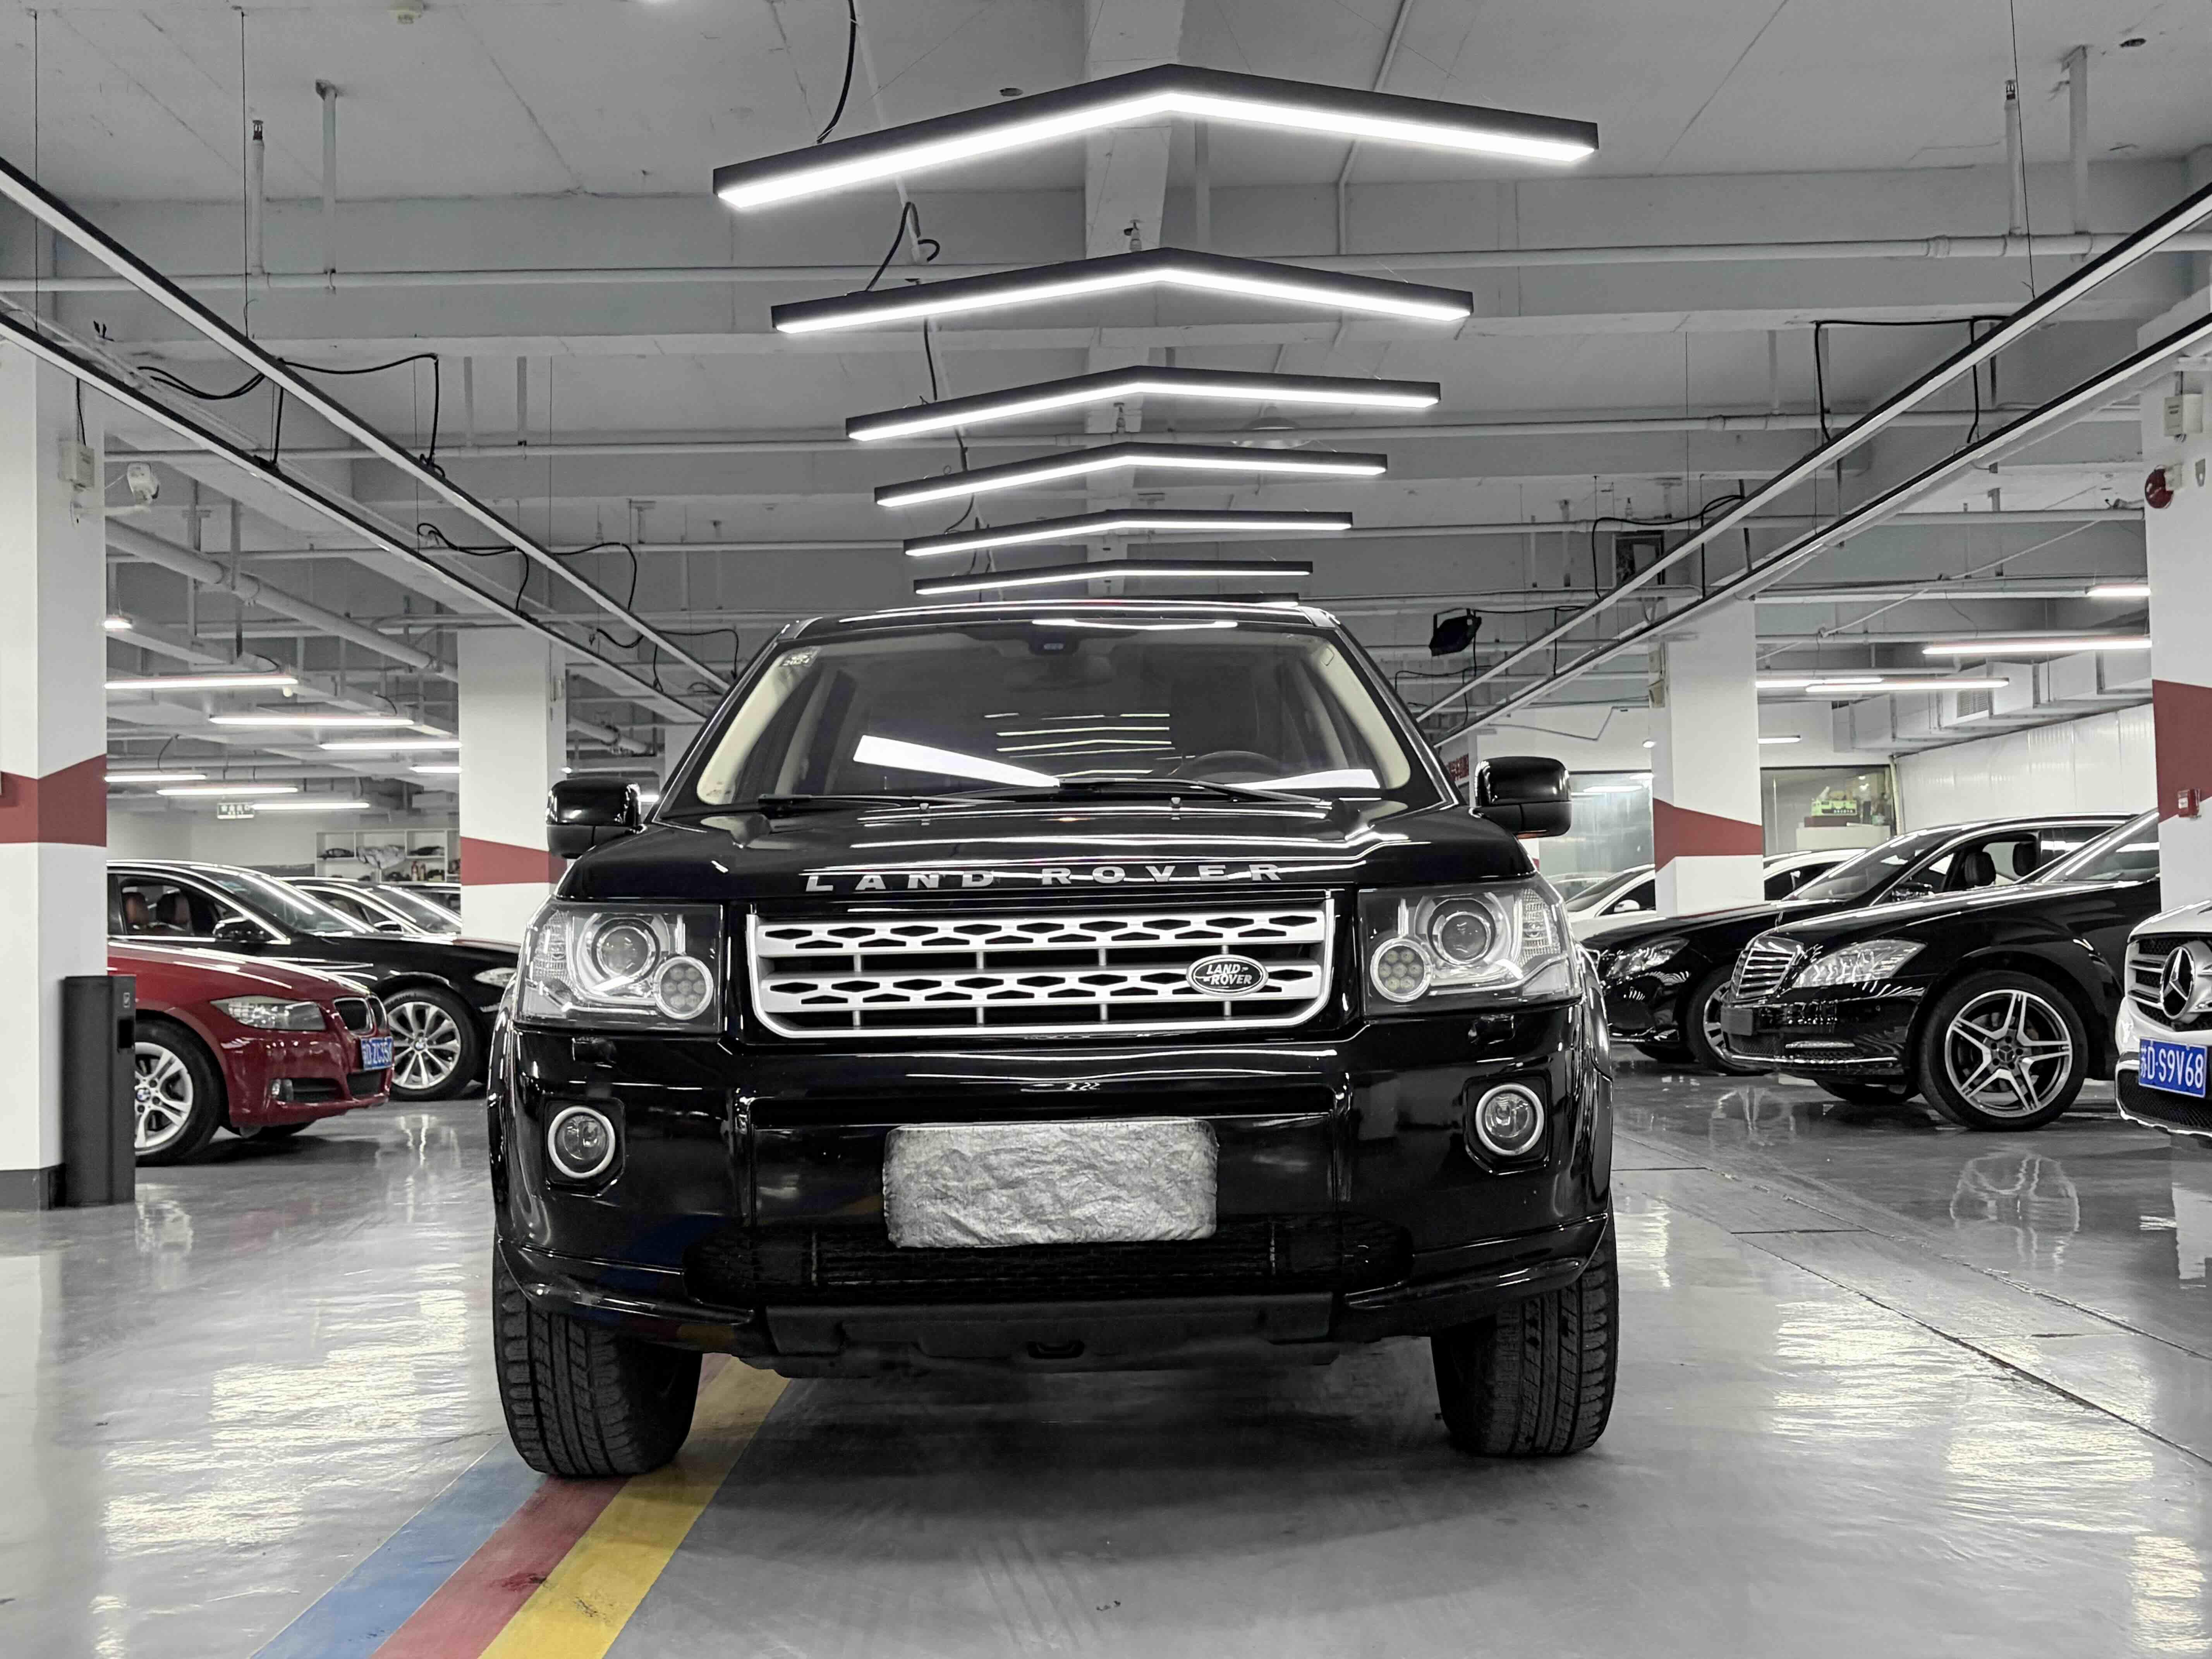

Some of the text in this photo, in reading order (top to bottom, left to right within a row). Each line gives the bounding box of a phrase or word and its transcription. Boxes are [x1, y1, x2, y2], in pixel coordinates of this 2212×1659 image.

[805, 864, 1281, 891] LAND ROVER
[1206, 963, 1241, 975] LAND
[1210, 974, 1252, 985] ROVER
